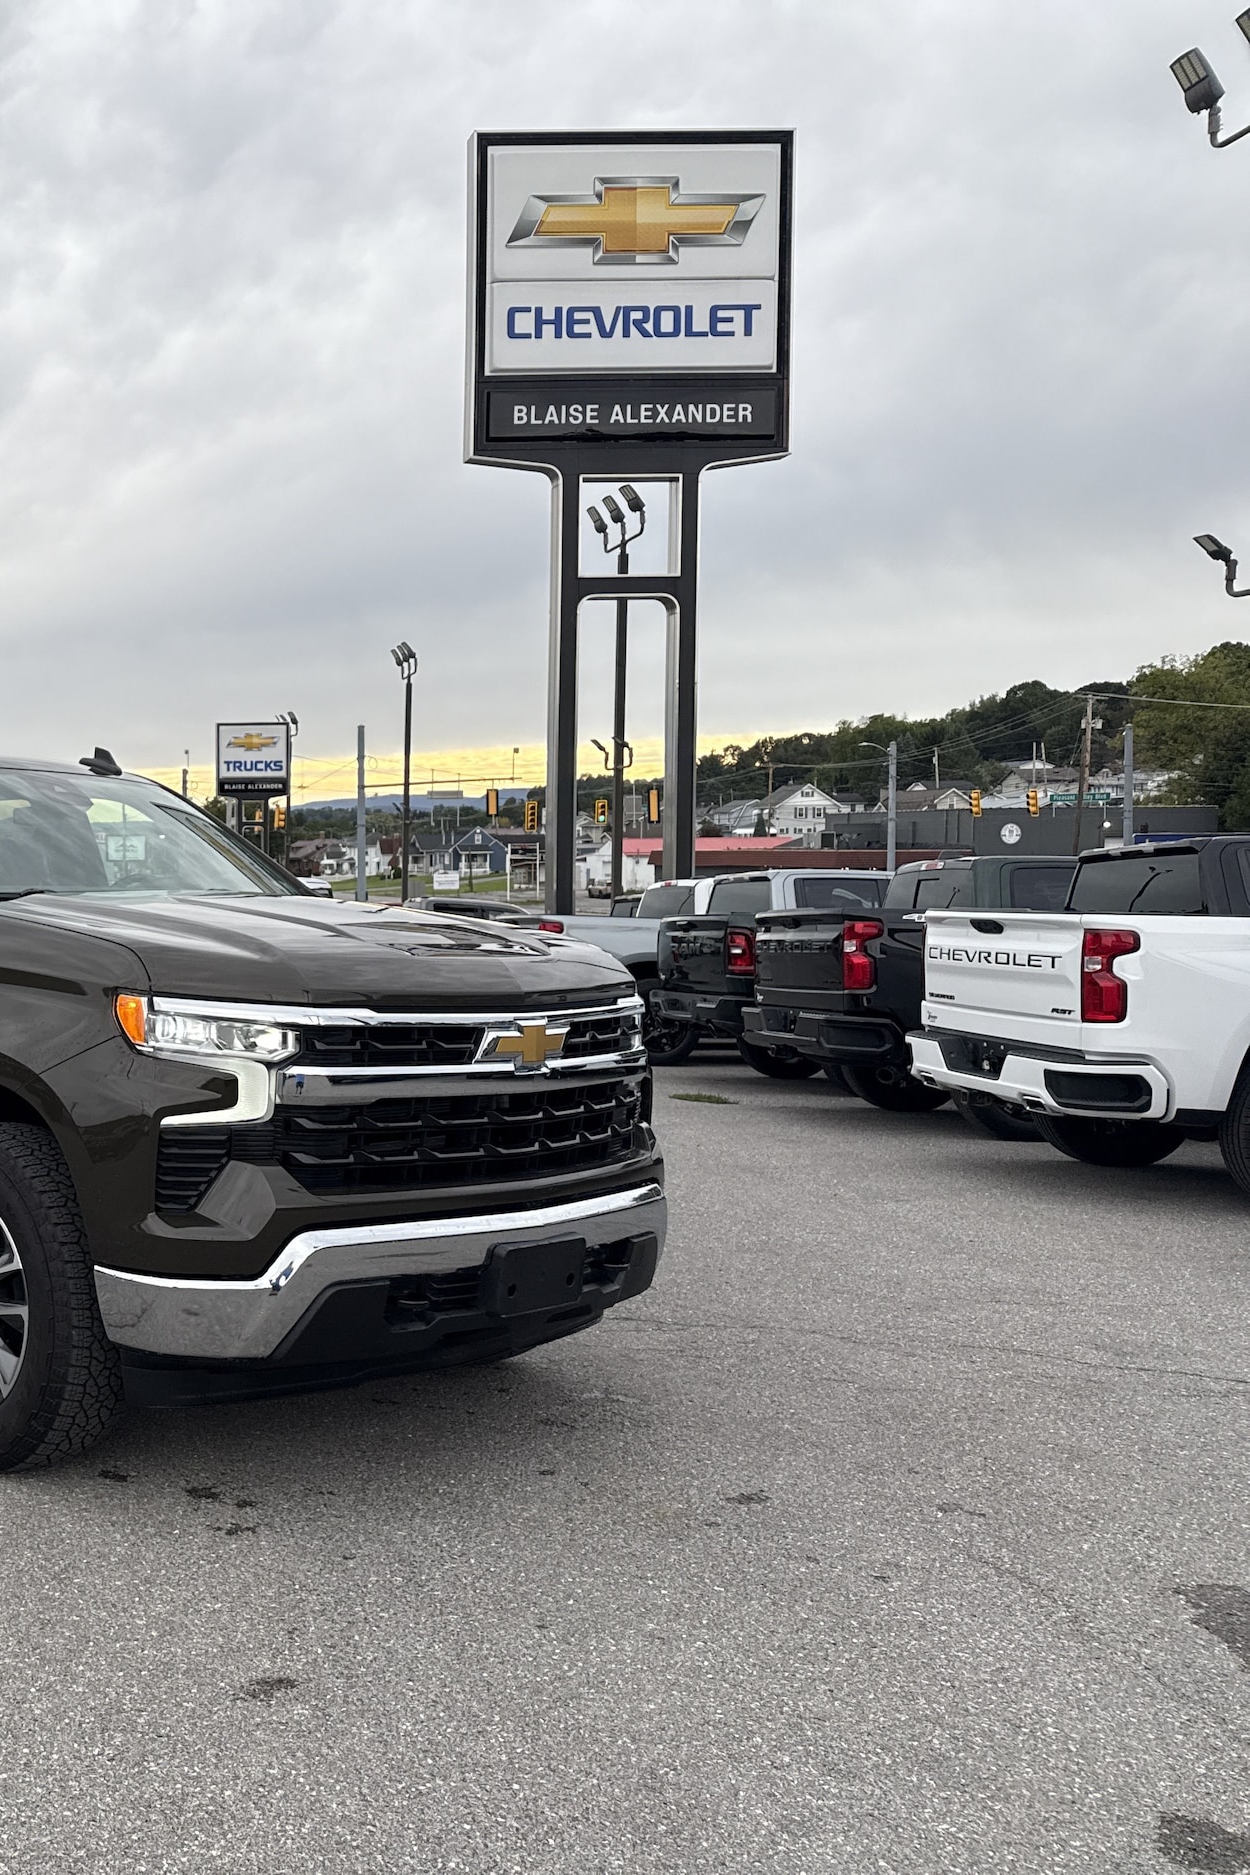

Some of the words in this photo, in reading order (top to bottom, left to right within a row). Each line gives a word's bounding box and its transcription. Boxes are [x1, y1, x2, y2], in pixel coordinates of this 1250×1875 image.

[506, 304, 762, 340] CHEVROLET
[513, 404, 600, 425] BLAISE
[609, 403, 753, 424] ALEXANDER
[224, 760, 284, 772] TRUCKS
[756, 940, 833, 953] CHEVROLET
[928, 946, 1063, 969] CHEVROLET
[1051, 1007, 1075, 1015] RST
